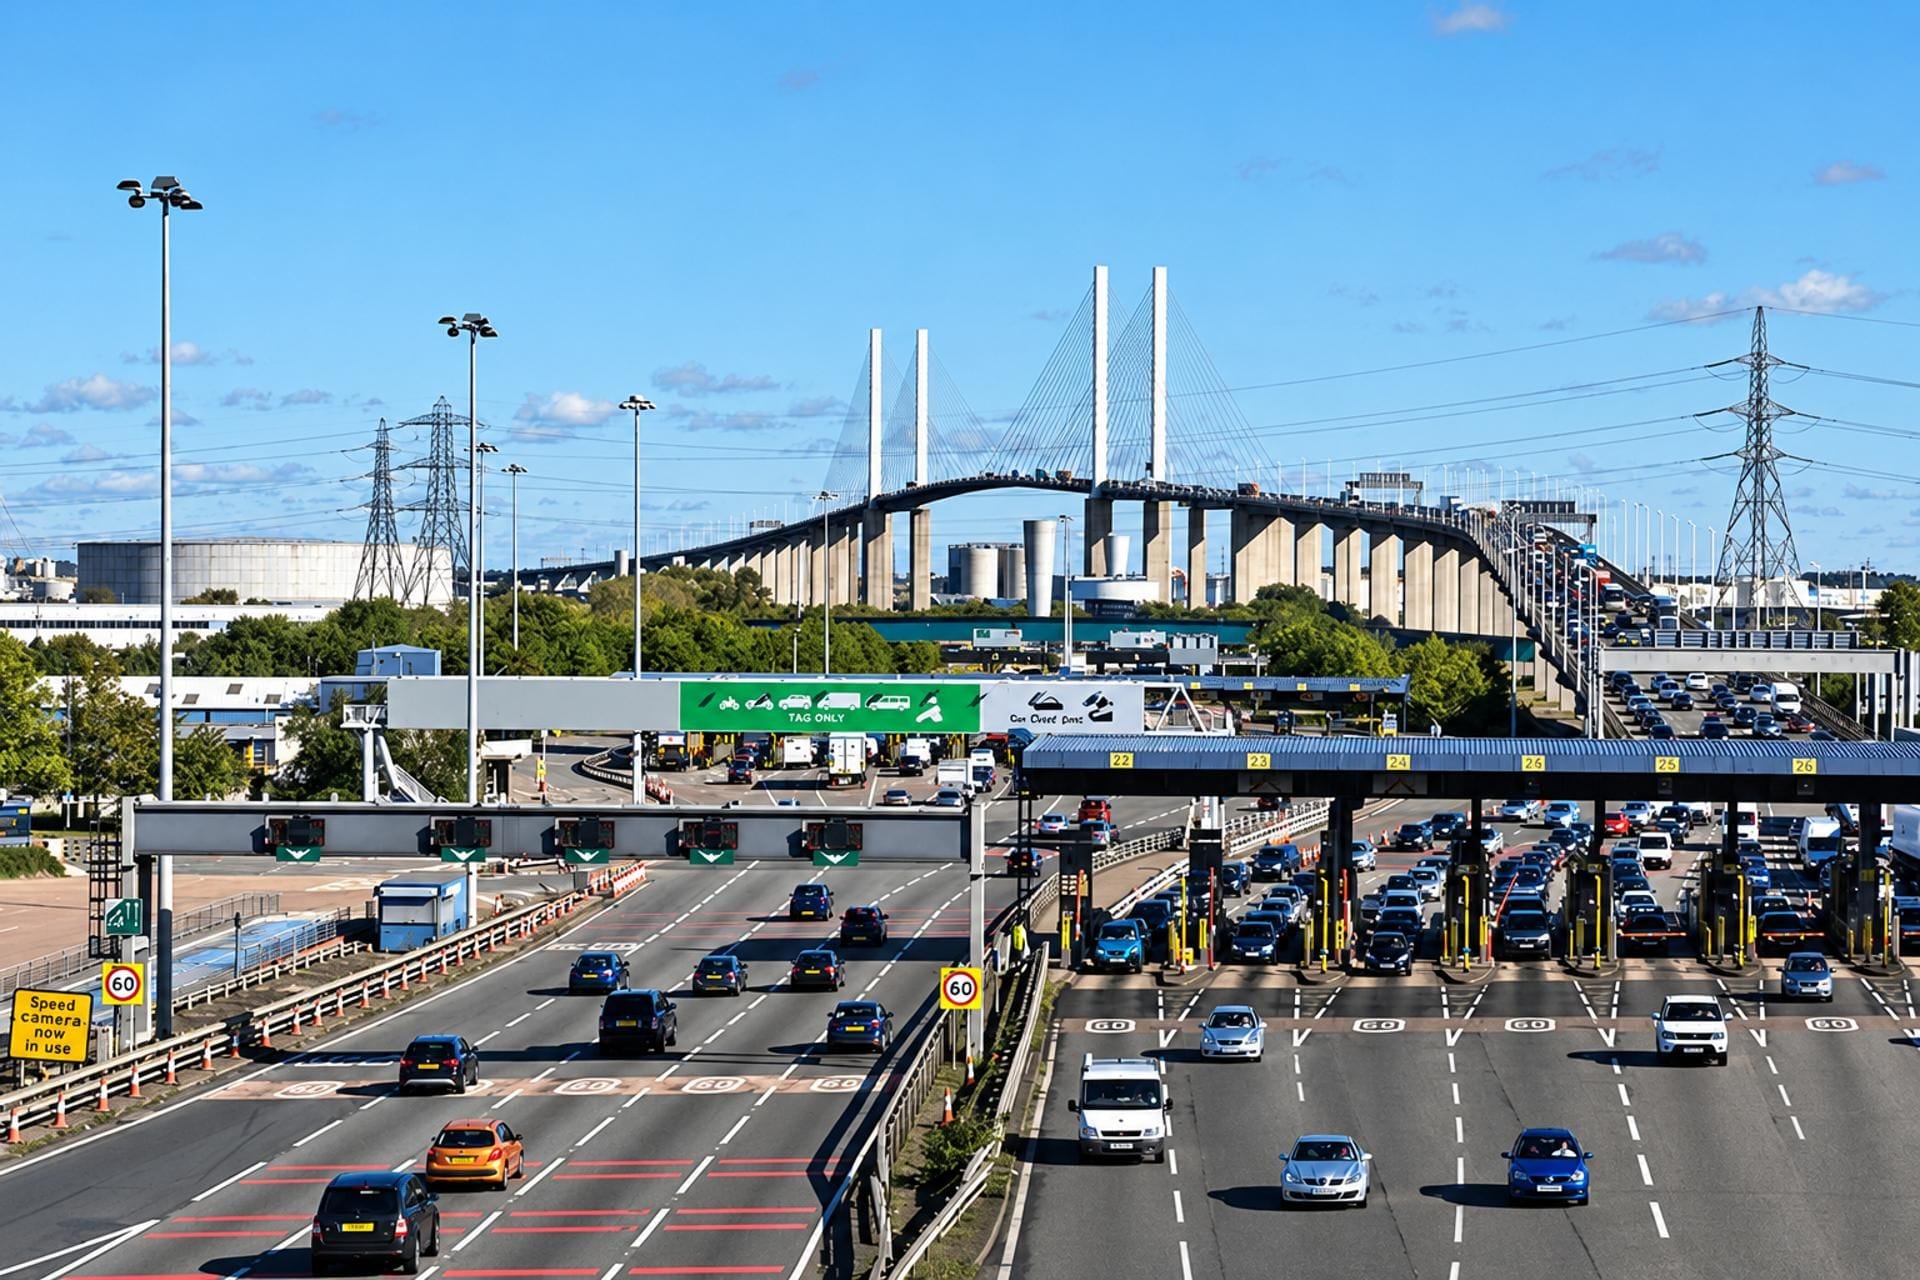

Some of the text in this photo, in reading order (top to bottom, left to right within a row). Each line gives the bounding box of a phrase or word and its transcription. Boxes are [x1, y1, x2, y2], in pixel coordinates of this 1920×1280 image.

[788, 713, 845, 722] TAG ONLY
[1113, 754, 1129, 766] 22
[1251, 755, 1267, 767] 23
[1390, 756, 1406, 768] 24
[1658, 759, 1676, 770] 25
[1796, 760, 1813, 772] 26
[112, 976, 134, 991] 60
[950, 981, 972, 996] 60
[30, 995, 76, 1011] Speed
[20, 1012, 81, 1027] camera
[34, 1027, 66, 1039] now
[25, 1039, 72, 1055] in use
